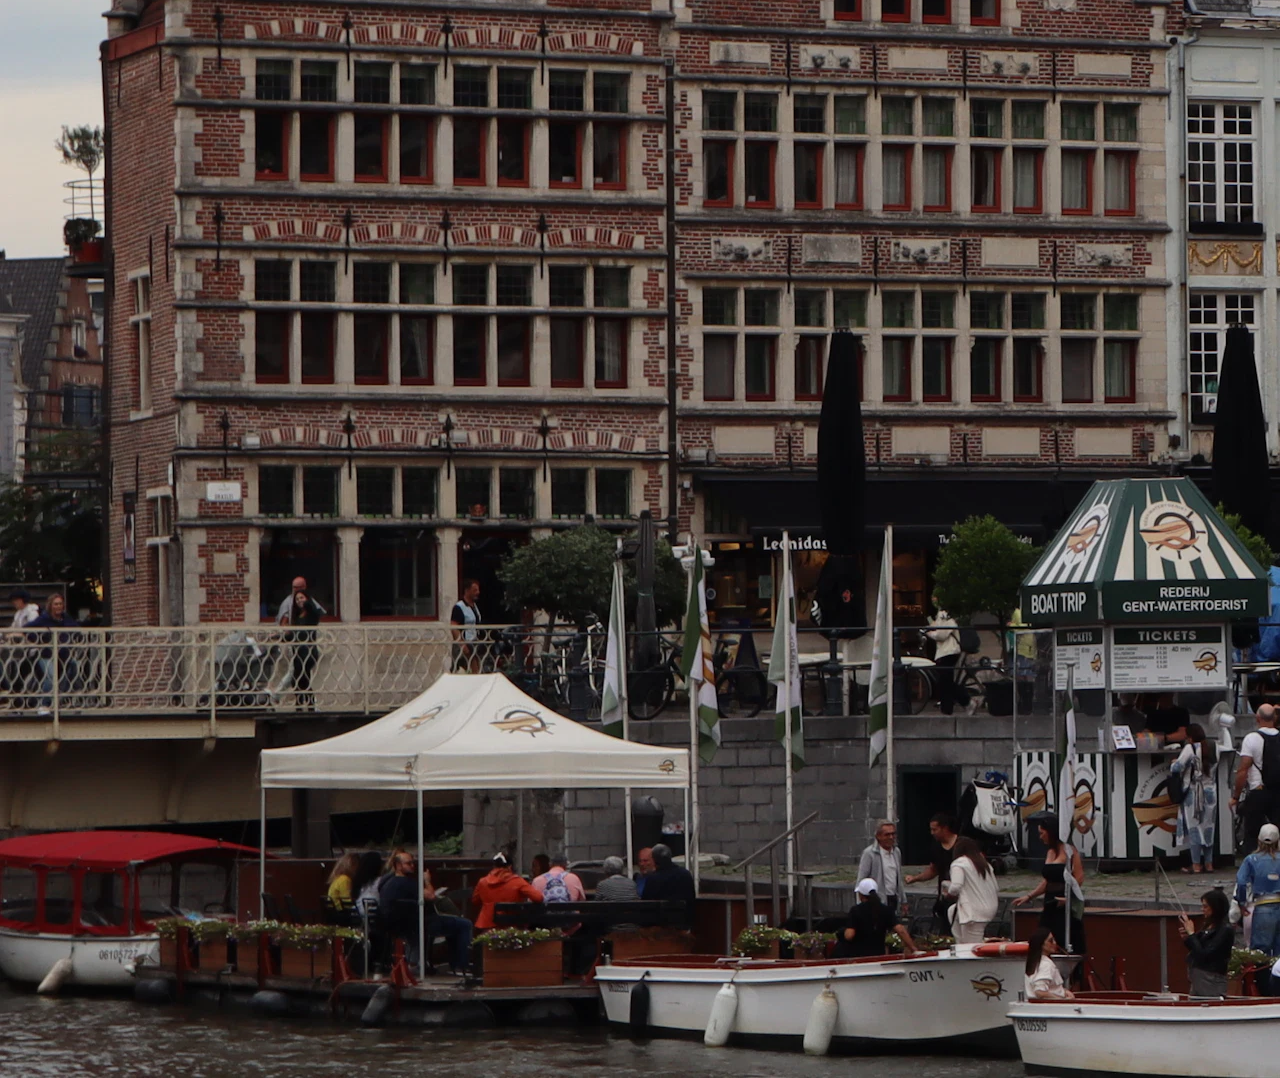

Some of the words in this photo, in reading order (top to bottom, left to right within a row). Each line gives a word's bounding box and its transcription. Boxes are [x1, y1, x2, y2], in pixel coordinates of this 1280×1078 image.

[1159, 586, 1210, 599] REDERIJ
[1030, 592, 1059, 614] BOAT
[1060, 591, 1087, 613] TRIP
[1122, 599, 1249, 613] GENT-WATERTOERIST
[1066, 632, 1093, 643] TICKETS
[1138, 631, 1197, 642] TICKETS
[909, 970, 934, 982] GWT
[937, 972, 945, 980] 4
